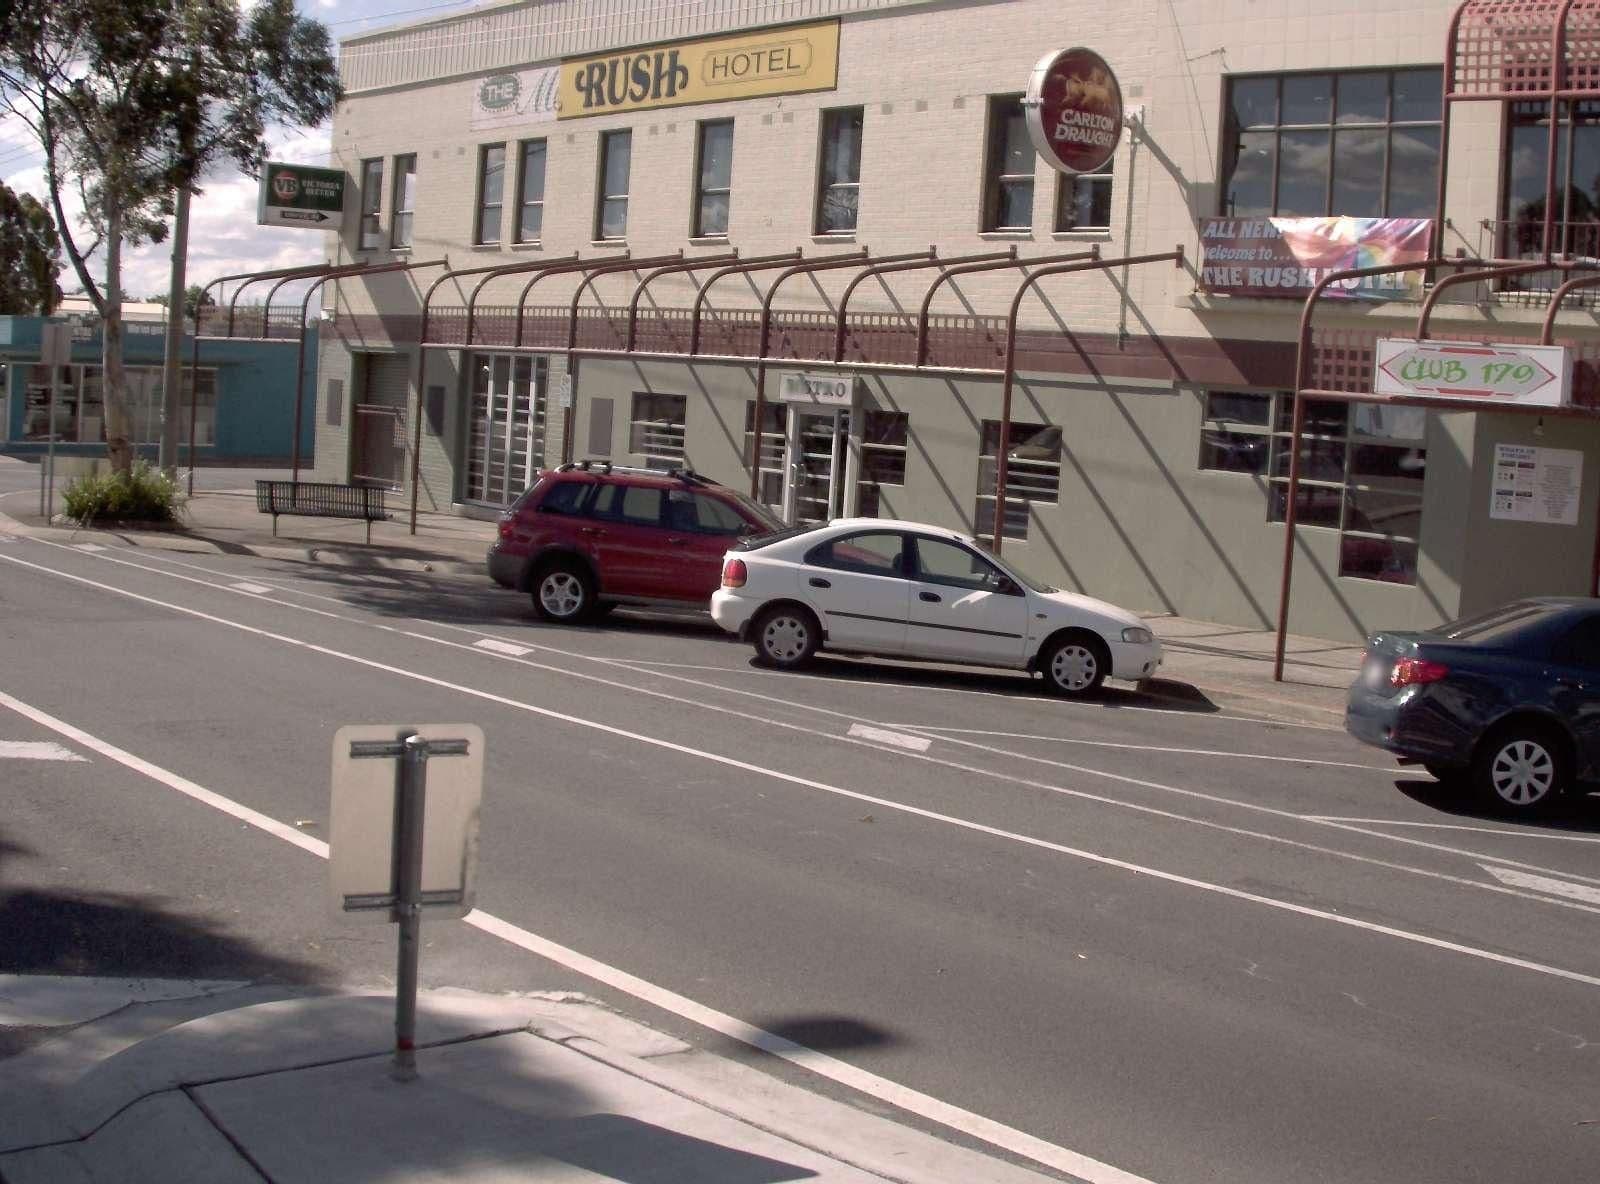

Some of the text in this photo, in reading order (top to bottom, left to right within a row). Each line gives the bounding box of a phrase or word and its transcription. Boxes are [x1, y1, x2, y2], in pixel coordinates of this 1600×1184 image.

[575, 46, 801, 108] RUSH HOTEL
[486, 81, 515, 101] THE
[1061, 108, 1114, 131] CARLTON
[1054, 123, 1114, 146] DRAUGHT
[274, 177, 298, 194] VB
[1203, 221, 1236, 239] ALL
[1202, 267, 1243, 286] THE
[1247, 267, 1316, 288] RUSH
[1401, 357, 1536, 384] CLUB 179
